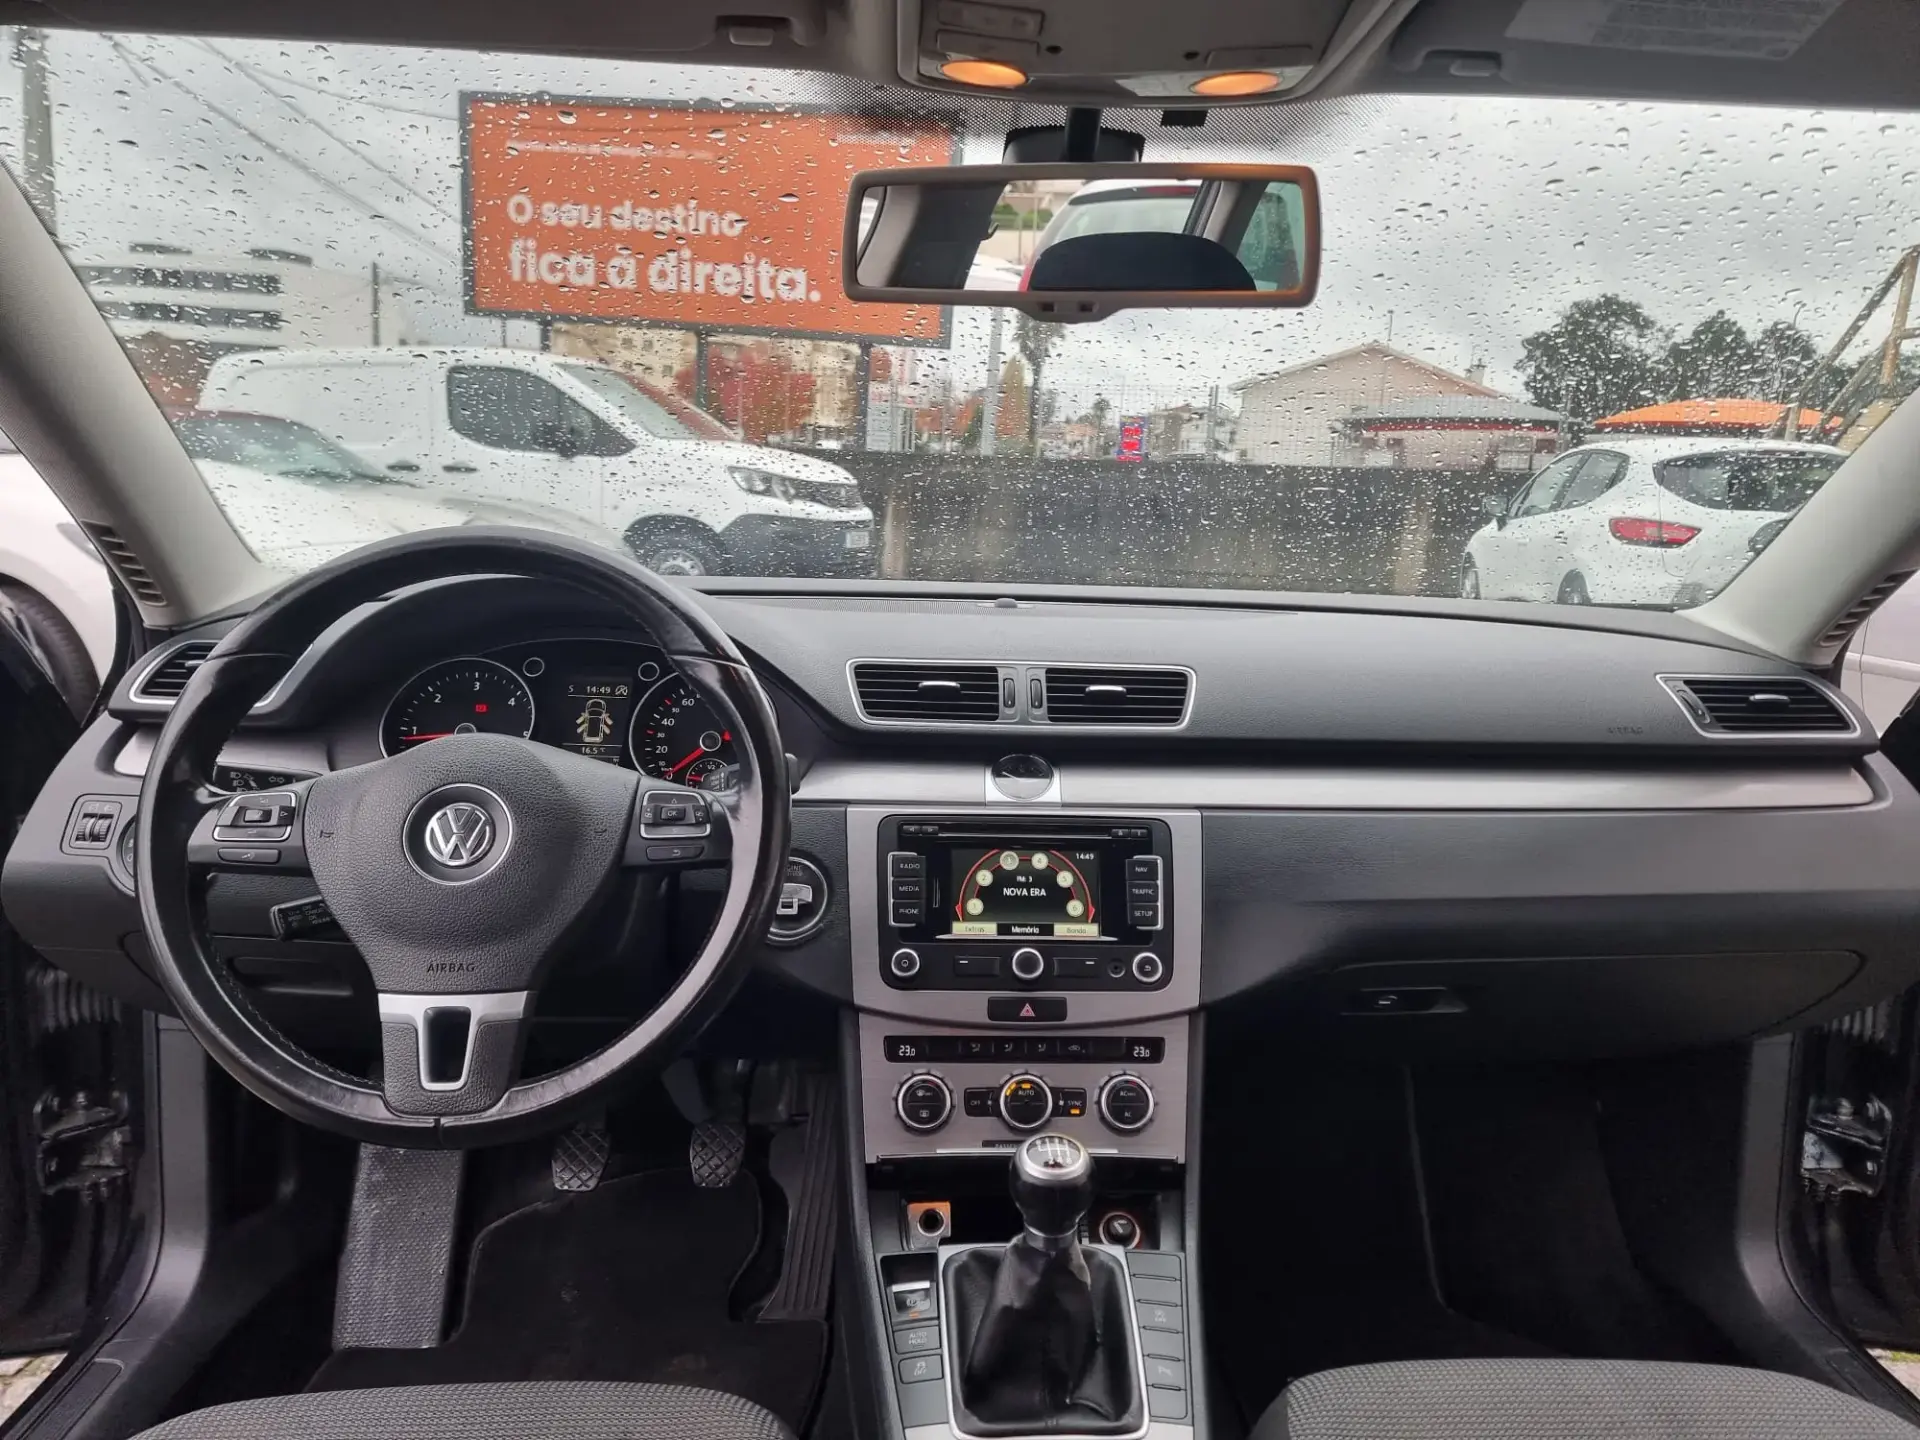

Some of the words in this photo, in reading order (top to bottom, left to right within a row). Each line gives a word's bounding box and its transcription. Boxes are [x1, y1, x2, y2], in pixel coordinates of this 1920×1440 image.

[507, 194, 533, 225] O
[541, 202, 602, 229] seu
[609, 200, 745, 237] destino
[508, 238, 597, 286] fica
[648, 249, 822, 303] direita.
[473, 682, 480, 691] 3
[586, 686, 611, 694] 14:49
[434, 693, 441, 703] 2
[508, 697, 515, 706] 4
[681, 698, 695, 707] 60
[661, 718, 675, 726] 40
[411, 726, 417, 735] 1
[655, 746, 668, 754] 20
[1003, 888, 1028, 896] NOVA
[1030, 888, 1047, 896] ERA
[1012, 925, 1040, 934] Memória
[427, 962, 475, 973] AIRBAG
